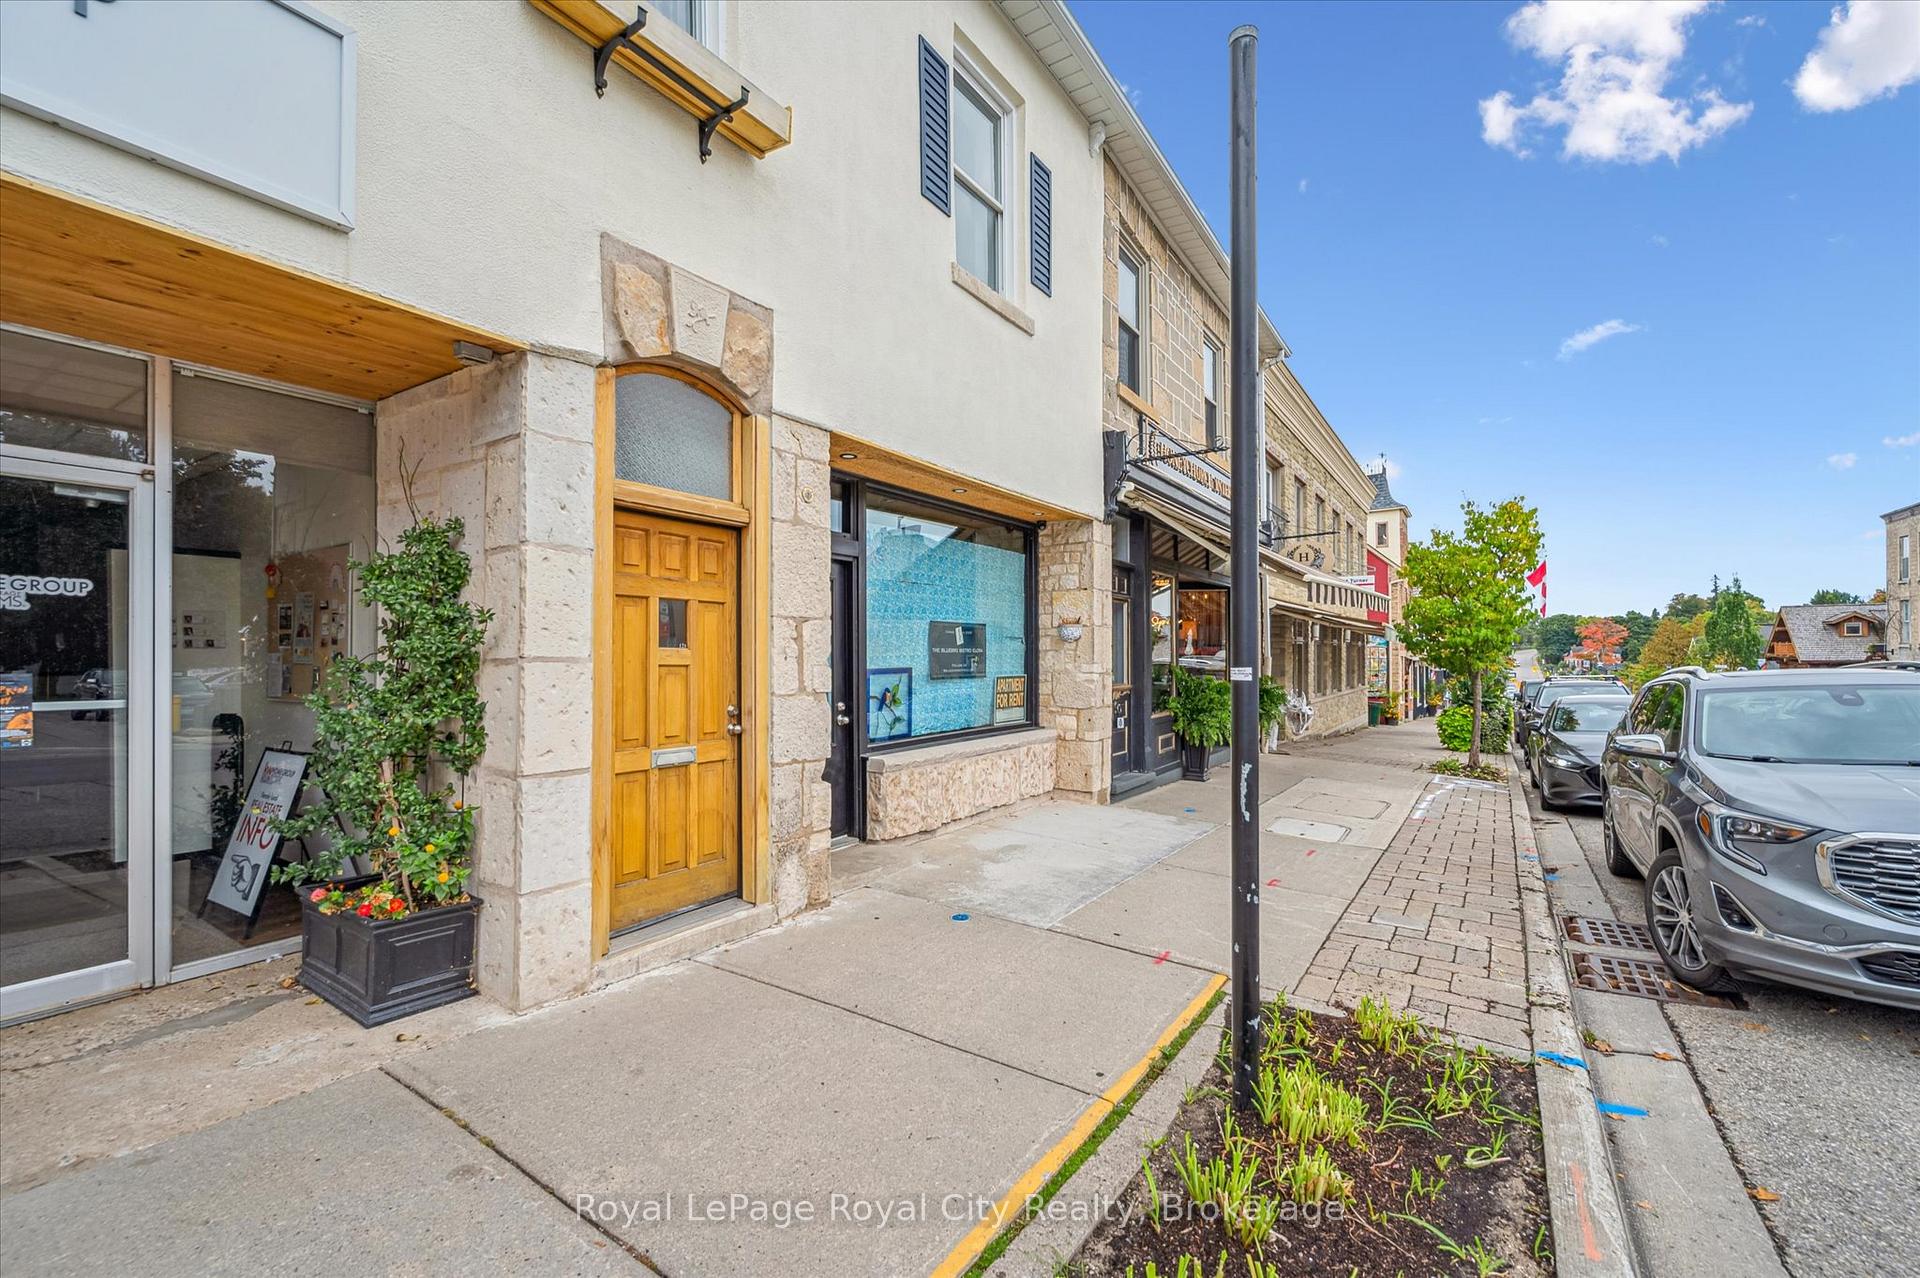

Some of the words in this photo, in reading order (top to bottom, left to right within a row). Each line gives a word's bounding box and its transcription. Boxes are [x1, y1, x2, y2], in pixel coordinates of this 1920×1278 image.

[1299, 552, 1309, 562] H
[996, 693, 1008, 708] FOR
[1008, 692, 1024, 706] RENT
[262, 802, 283, 816] ESTATE
